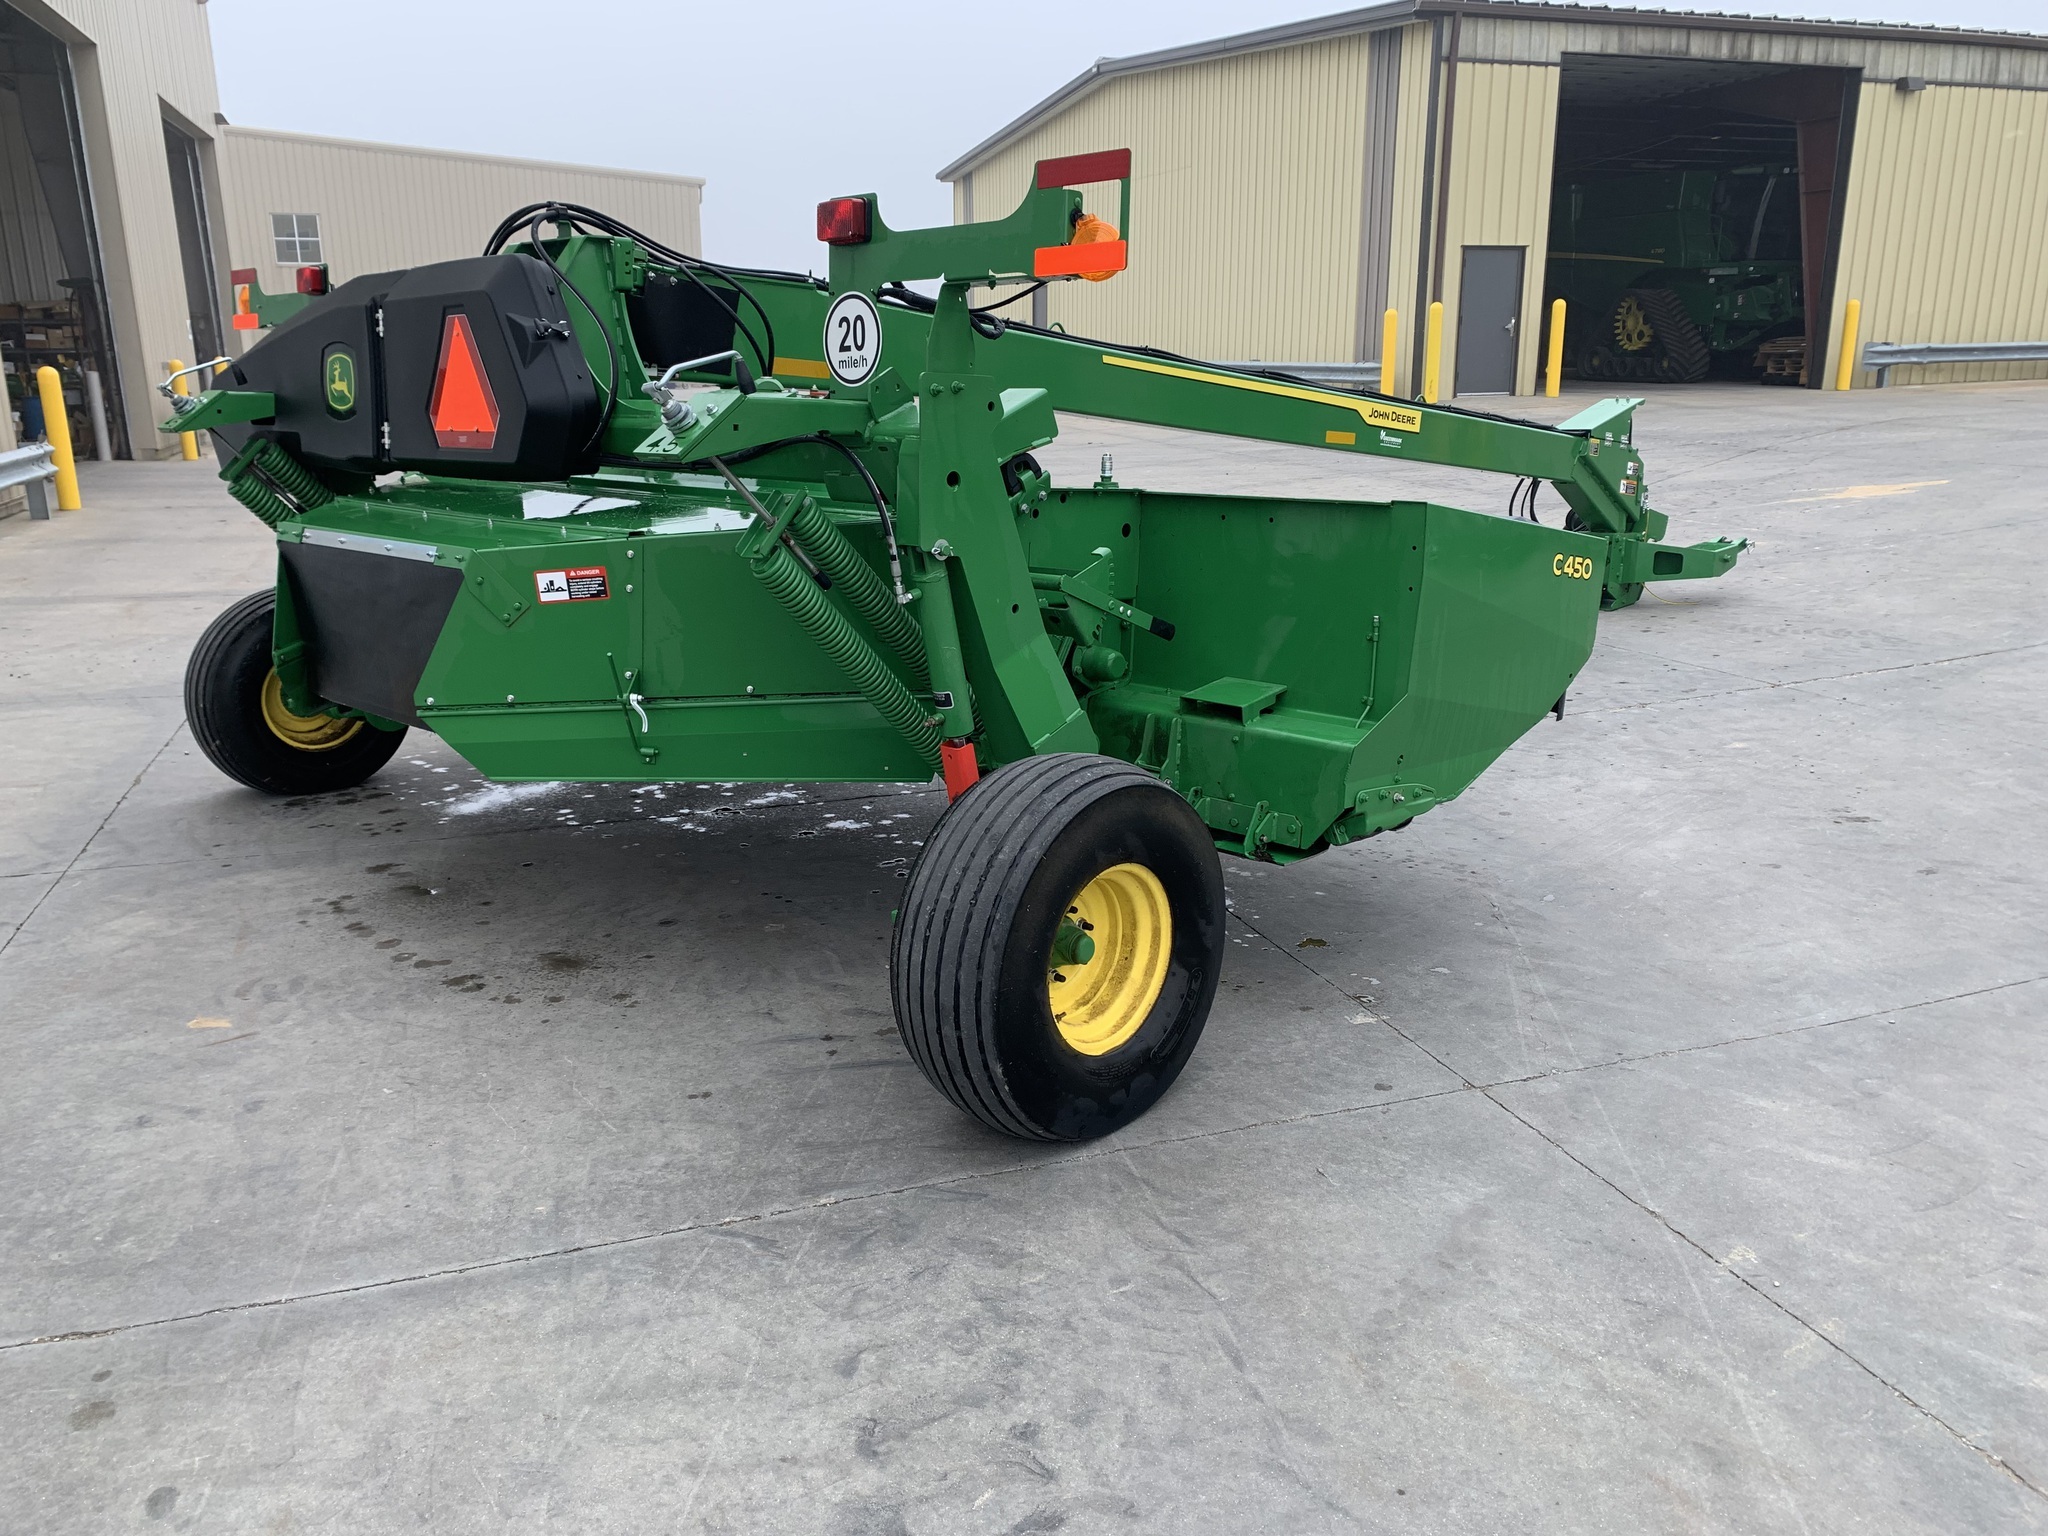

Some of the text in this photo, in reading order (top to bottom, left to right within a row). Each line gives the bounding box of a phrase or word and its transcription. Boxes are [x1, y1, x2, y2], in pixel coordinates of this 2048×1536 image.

[838, 314, 866, 353] 20
[838, 355, 868, 370] mile/h
[1368, 407, 1417, 426] JOHN DEERE
[646, 436, 686, 453] 4.5
